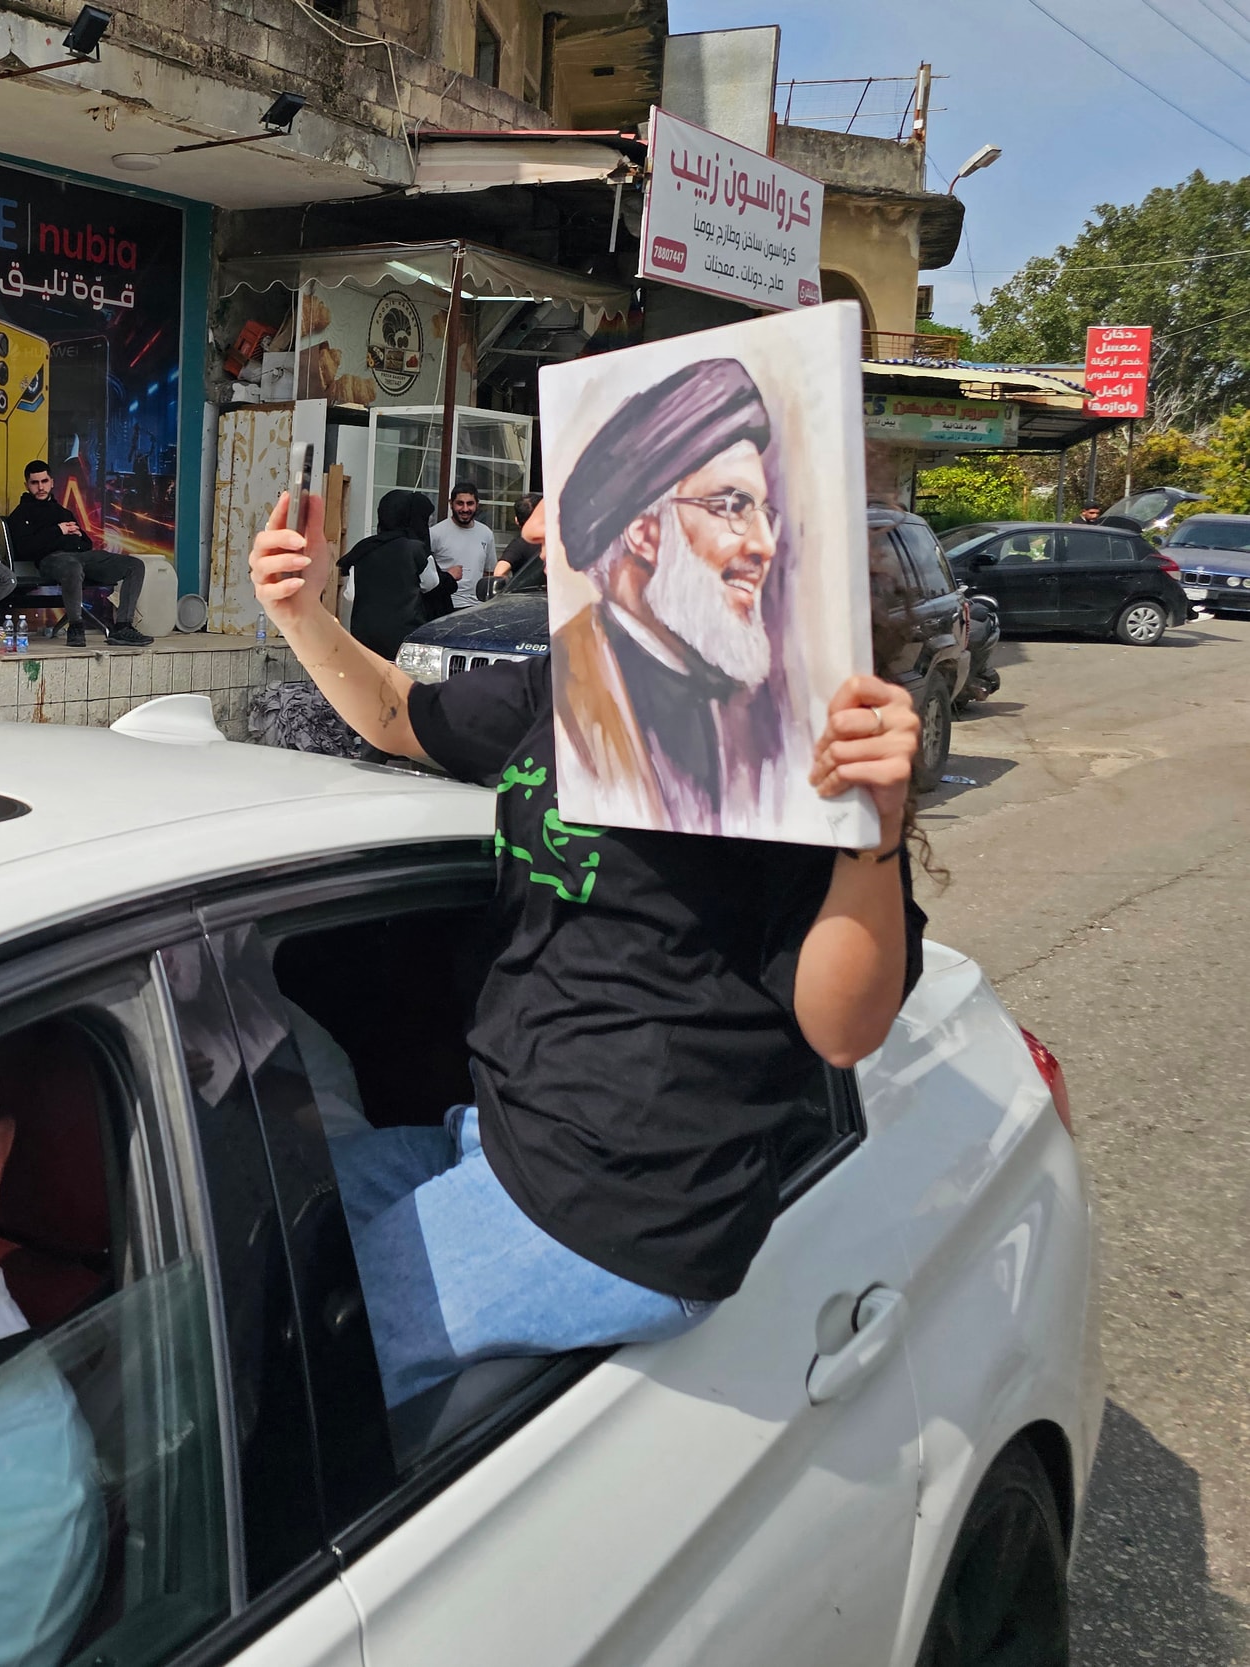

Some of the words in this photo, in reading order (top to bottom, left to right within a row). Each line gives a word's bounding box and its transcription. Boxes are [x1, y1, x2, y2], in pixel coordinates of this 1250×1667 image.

[670, 149, 720, 205] زبيب
[724, 157, 811, 232] كرواسون
[39, 222, 137, 271] nubia
[716, 224, 740, 251] وطازج
[741, 231, 762, 252] ساخن
[653, 245, 685, 264] 78807447
[763, 238, 796, 266] كرواسون
[705, 254, 735, 279] معجنات
[741, 265, 763, 290] دونات
[0, 261, 69, 301] تليق
[515, 642, 548, 652] Jeep
